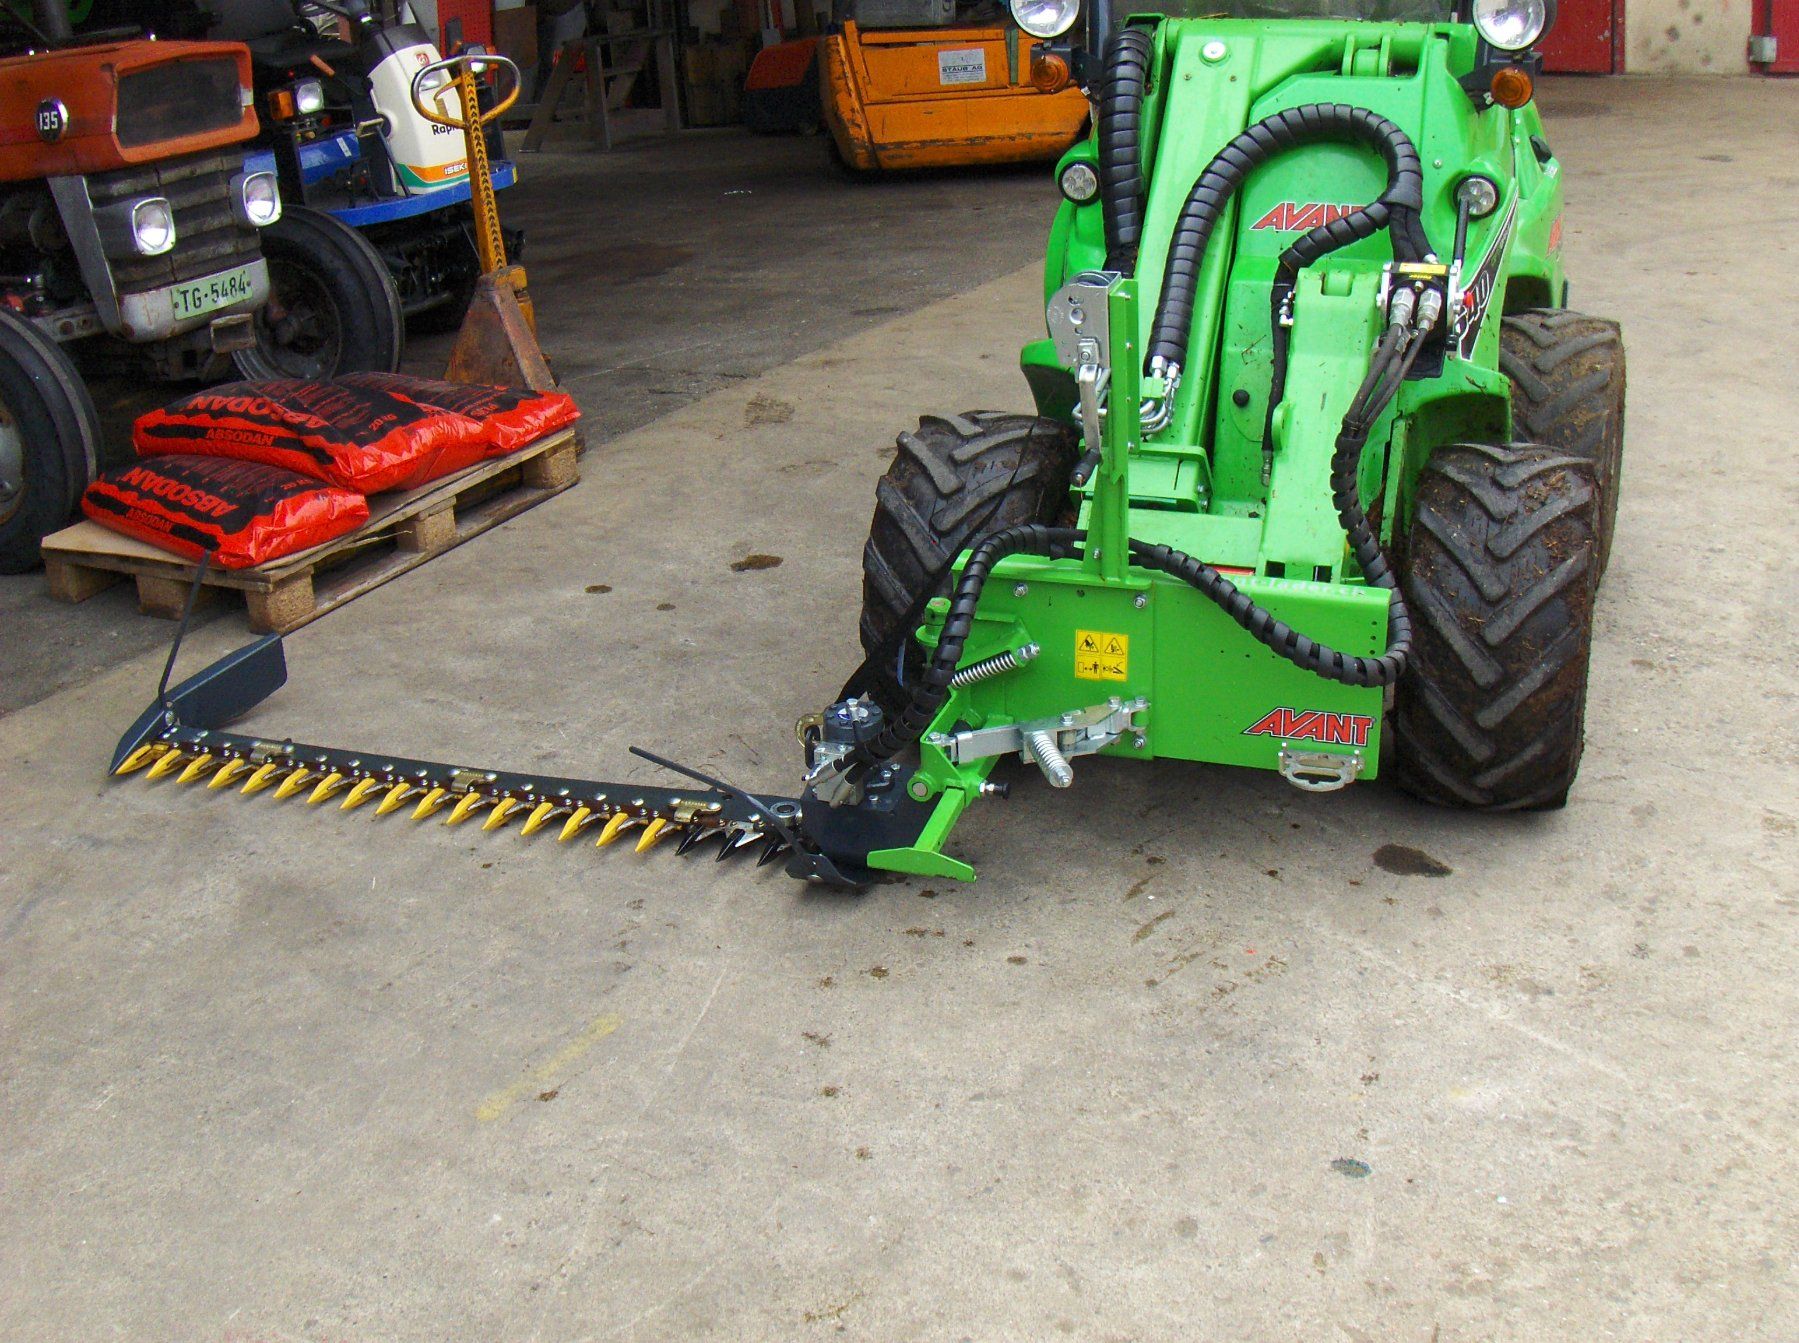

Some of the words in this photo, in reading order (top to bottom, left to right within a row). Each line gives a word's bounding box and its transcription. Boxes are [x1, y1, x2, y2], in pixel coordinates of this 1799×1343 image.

[40, 111, 58, 130] 135
[206, 428, 274, 447] ABSODAN
[122, 467, 239, 518] ABSODAN
[1240, 707, 1374, 746] AVANT
